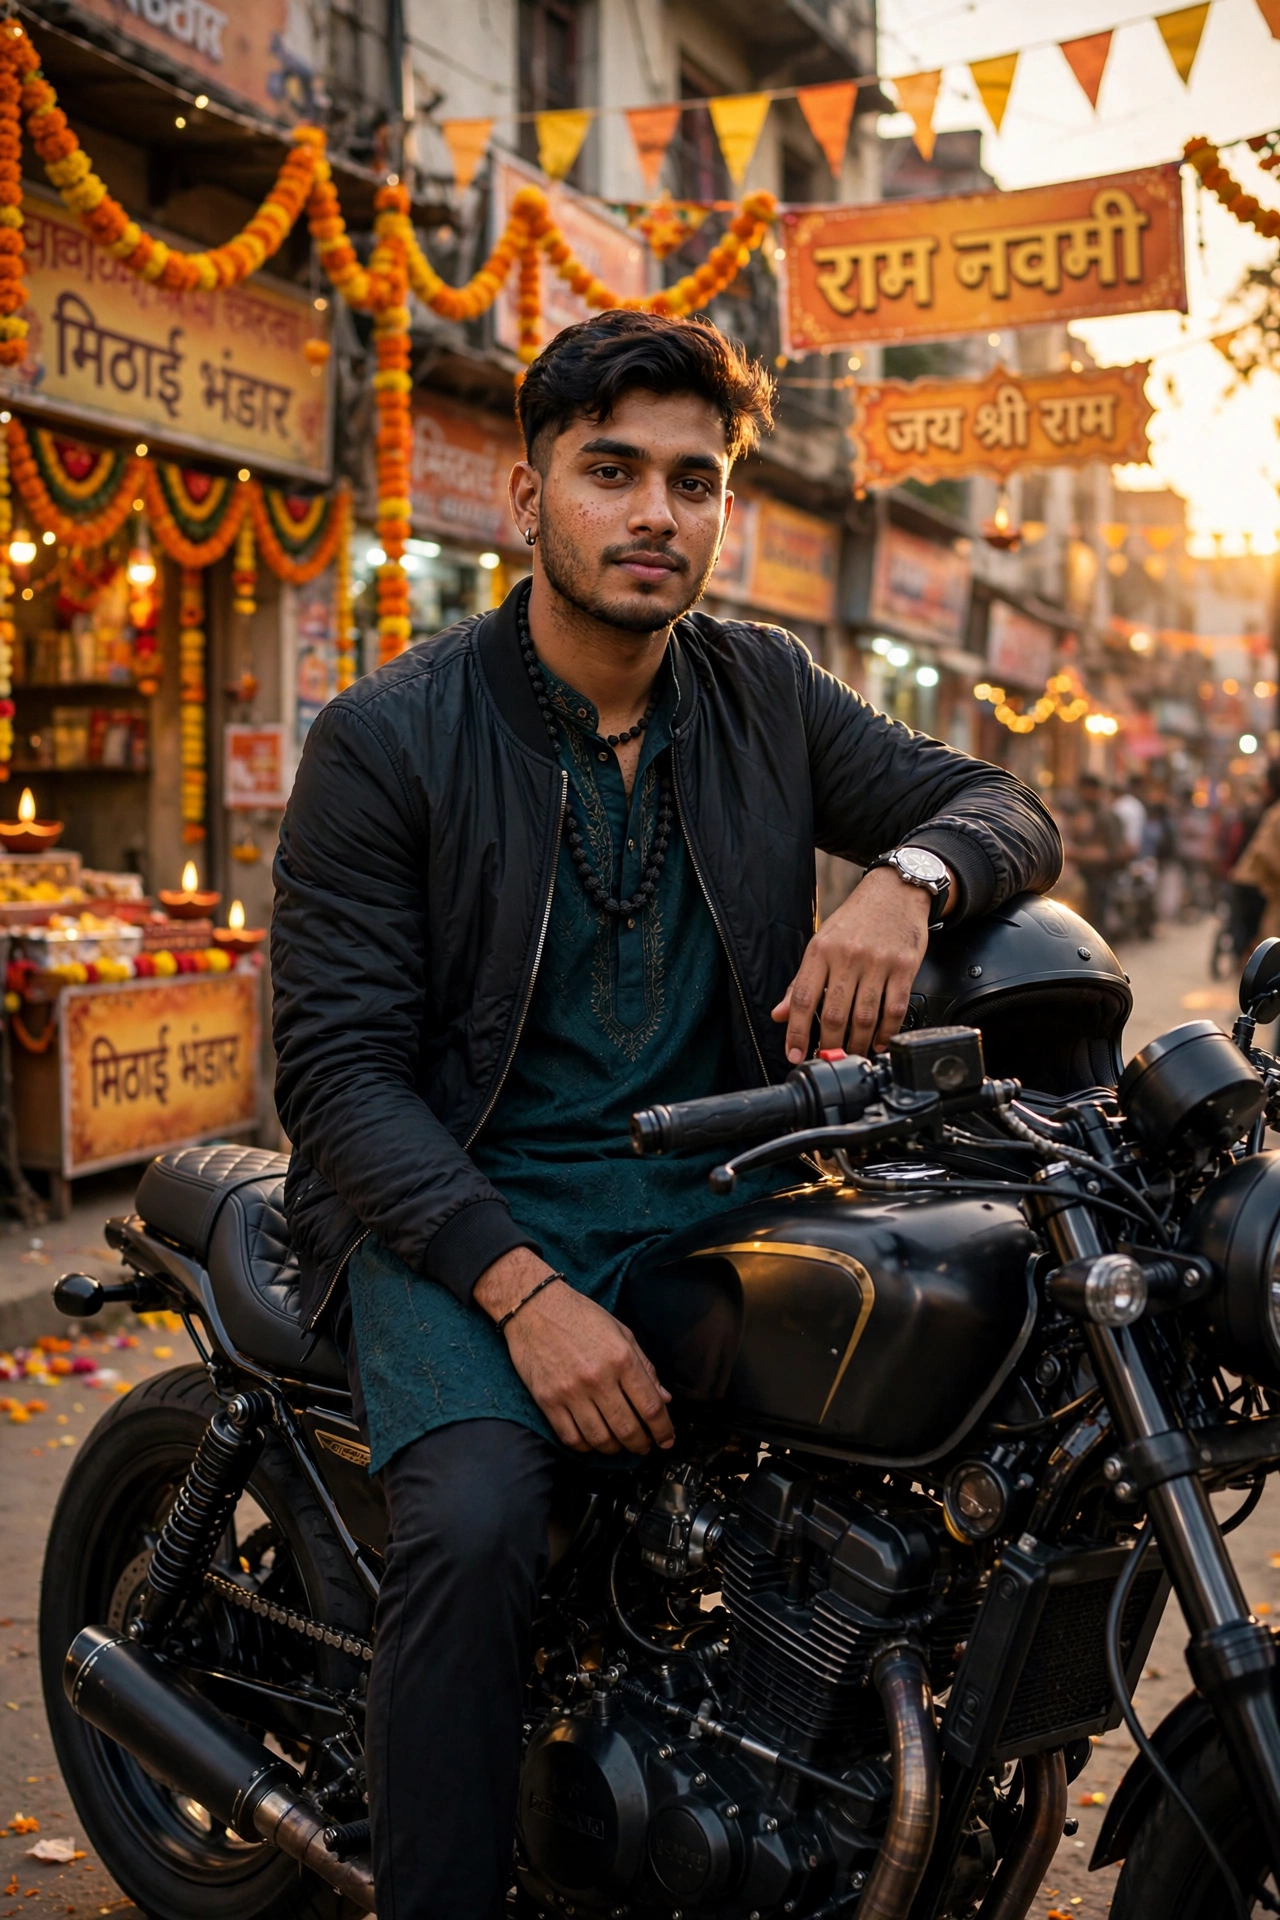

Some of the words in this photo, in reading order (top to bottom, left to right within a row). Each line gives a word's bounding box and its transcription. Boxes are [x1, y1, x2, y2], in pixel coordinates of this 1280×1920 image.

[813, 236, 939, 316] राम
[952, 188, 1150, 300] नवमी
[53, 291, 184, 418] मिठाई
[200, 349, 293, 438] भंडार
[887, 406, 965, 454] जय
[973, 384, 1031, 450] श्री
[1038, 393, 1118, 445] राम
[90, 1024, 169, 1108] मिठाई
[179, 1022, 240, 1089] भंडार
